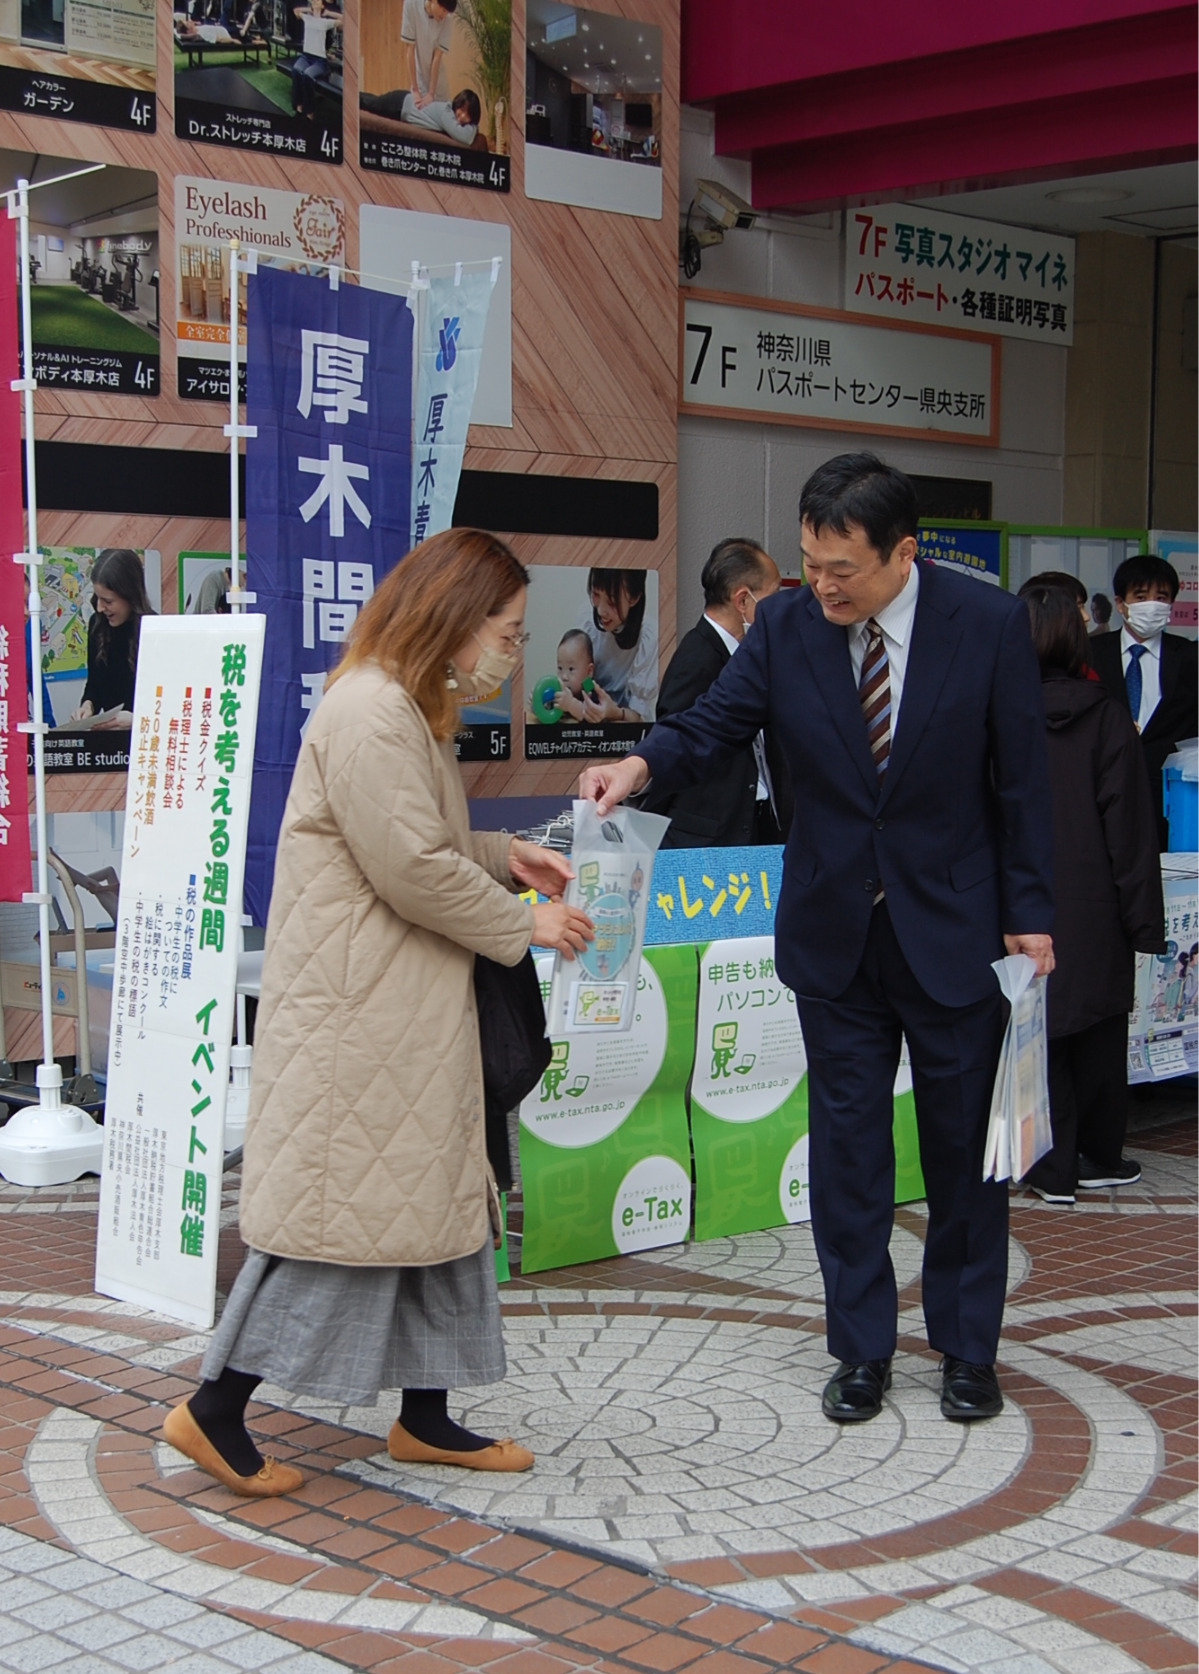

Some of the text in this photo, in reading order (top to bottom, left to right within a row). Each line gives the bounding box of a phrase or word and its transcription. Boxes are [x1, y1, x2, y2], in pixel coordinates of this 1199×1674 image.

[24, 92, 74, 113] ガーデン
[131, 97, 151, 126] 4F
[189, 120, 306, 153] Dr.ストレッチ本厚木店
[320, 130, 339, 158] 4F
[381, 142, 428, 160] こころ整体院
[489, 160, 506, 187] 4F
[185, 186, 268, 221] Eyelash
[186, 218, 292, 248] Professhionals
[854, 213, 1068, 292] 7F 写真スタジオマイネ
[855, 272, 1068, 333] パスポート・各種証明写真
[686, 323, 738, 388] 7F
[756, 330, 832, 368] 神奈川県
[134, 361, 155, 389] 4F
[756, 366, 986, 420] パスポートセンター県央支所
[175, 700, 192, 809] 税理士による
[195, 700, 212, 791] 税金クイズ
[490, 730, 507, 755] 5F
[77, 752, 91, 766] BE
[163, 717, 180, 809] 無料相談会
[200, 643, 246, 952] 税を考える週間
[706, 1076, 789, 1099] www.e-tax.nta.go.jp
[181, 998, 218, 1257] イベント開催
[535, 1100, 626, 1123] www.e-tax.nta.go.jp
[622, 1195, 683, 1227] e-Tax
